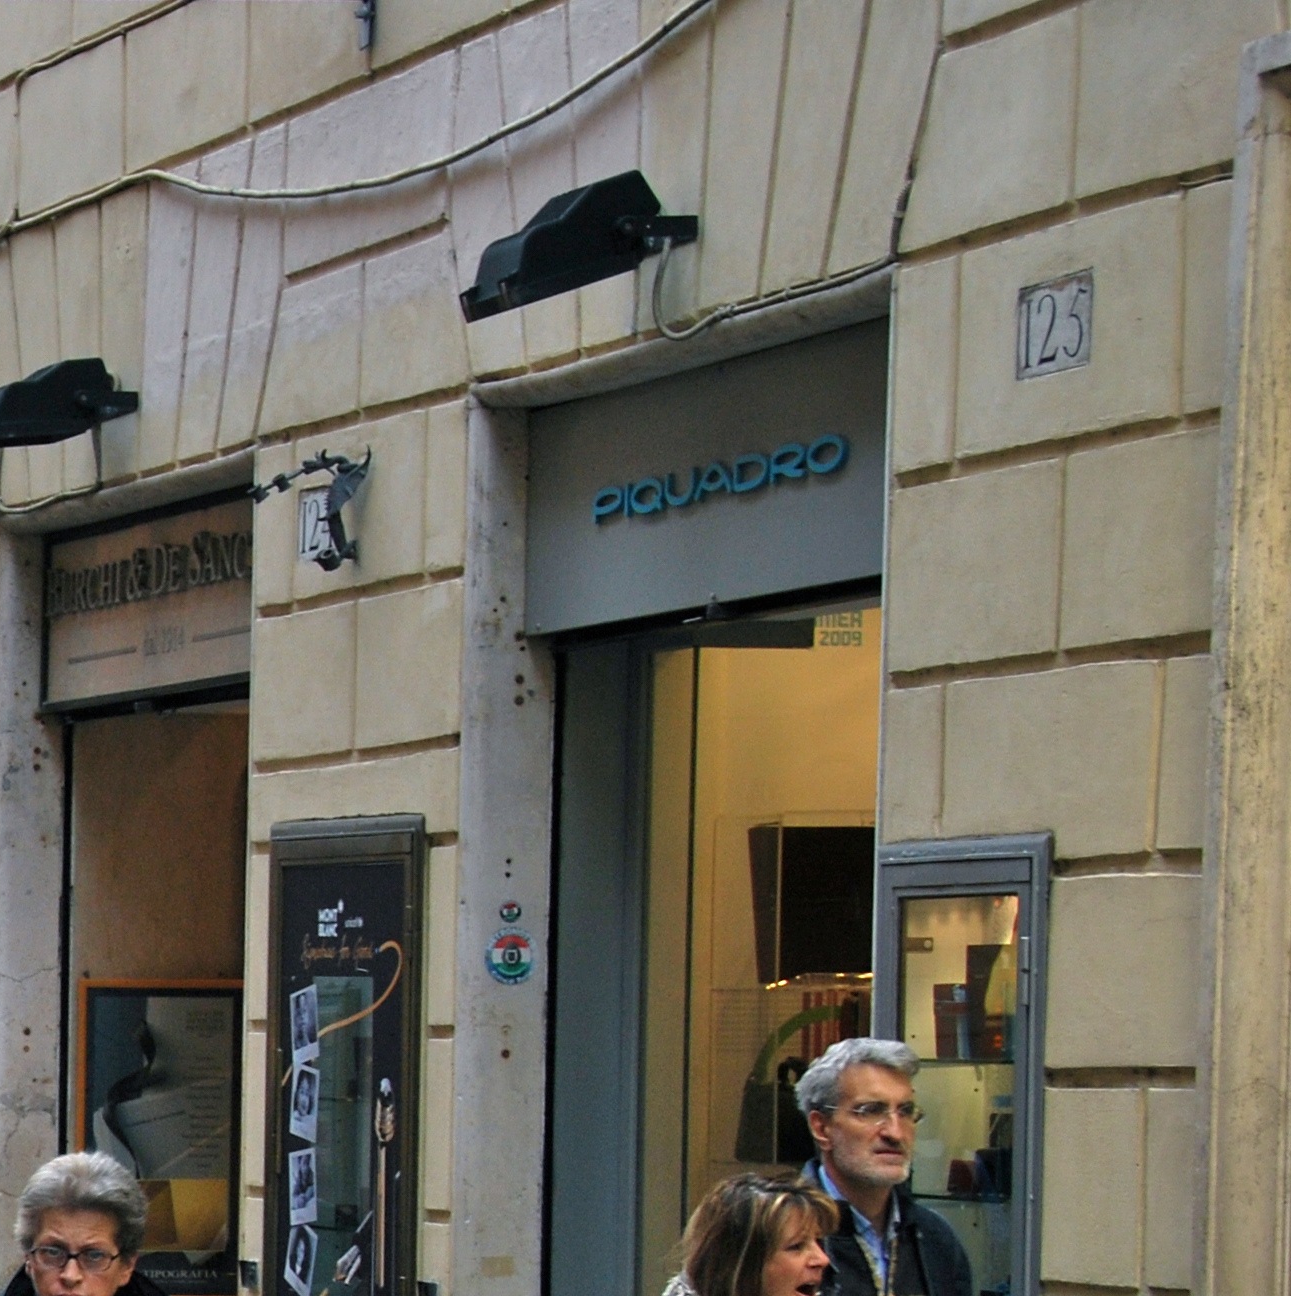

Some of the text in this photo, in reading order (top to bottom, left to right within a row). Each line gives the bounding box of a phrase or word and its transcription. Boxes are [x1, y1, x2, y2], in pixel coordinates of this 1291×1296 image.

[1022, 286, 1087, 369] 125
[592, 433, 849, 525] PIQUADRO
[187, 530, 252, 587] SANC
[819, 630, 863, 647] 2009
